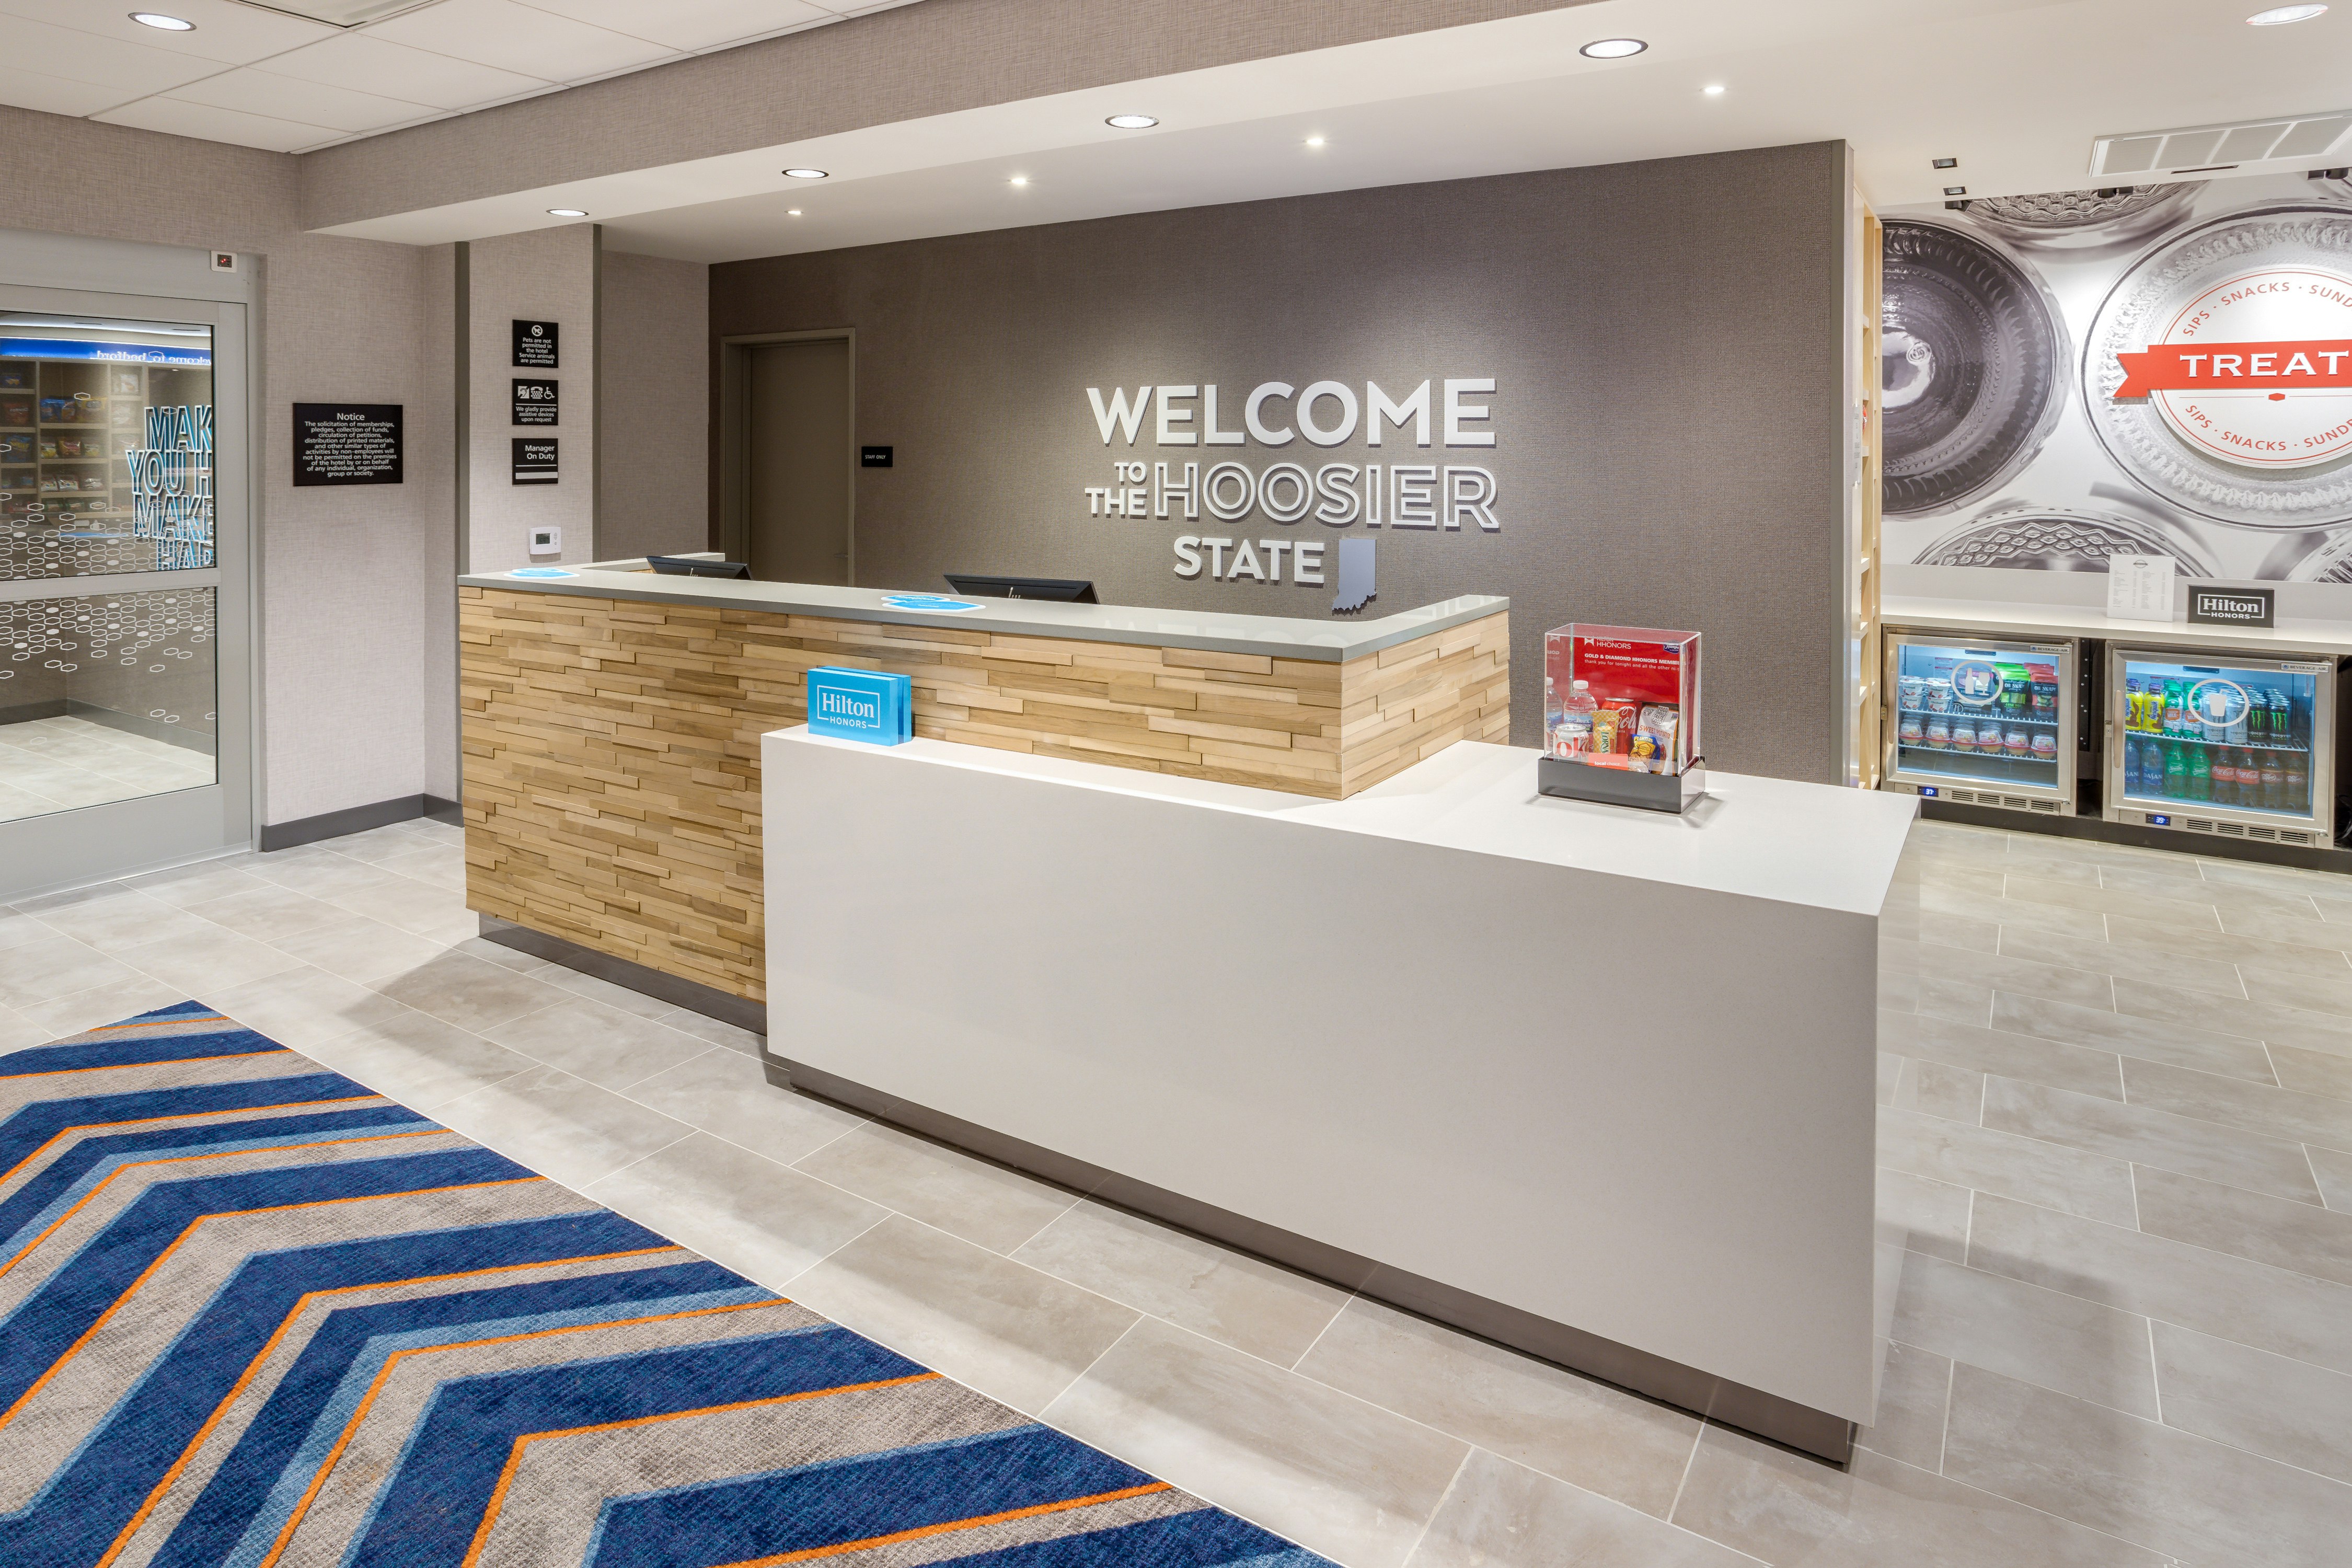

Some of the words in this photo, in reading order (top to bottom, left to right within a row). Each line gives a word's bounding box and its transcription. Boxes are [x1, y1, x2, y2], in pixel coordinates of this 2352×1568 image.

[2183, 310, 2210, 336] SIPS
[2221, 282, 2290, 305] SNACKS
[2180, 351, 2349, 377] TREAT
[1086, 378, 1496, 447] WELCOME
[2185, 405, 2212, 428] SIPS
[2221, 431, 2286, 451] SNACKS
[1114, 462, 1147, 482] TO
[1085, 488, 1147, 516] THE
[1155, 462, 1500, 528] HOOSIER
[1173, 536, 1324, 583] STATE
[2203, 598, 2258, 613] Hilton
[822, 692, 875, 718] Hilton
[2150, 701, 2159, 720] Nesquik
[830, 717, 867, 729] HONORS
[1639, 725, 1656, 733] SWEET
[1656, 730, 1670, 739] POTATO
